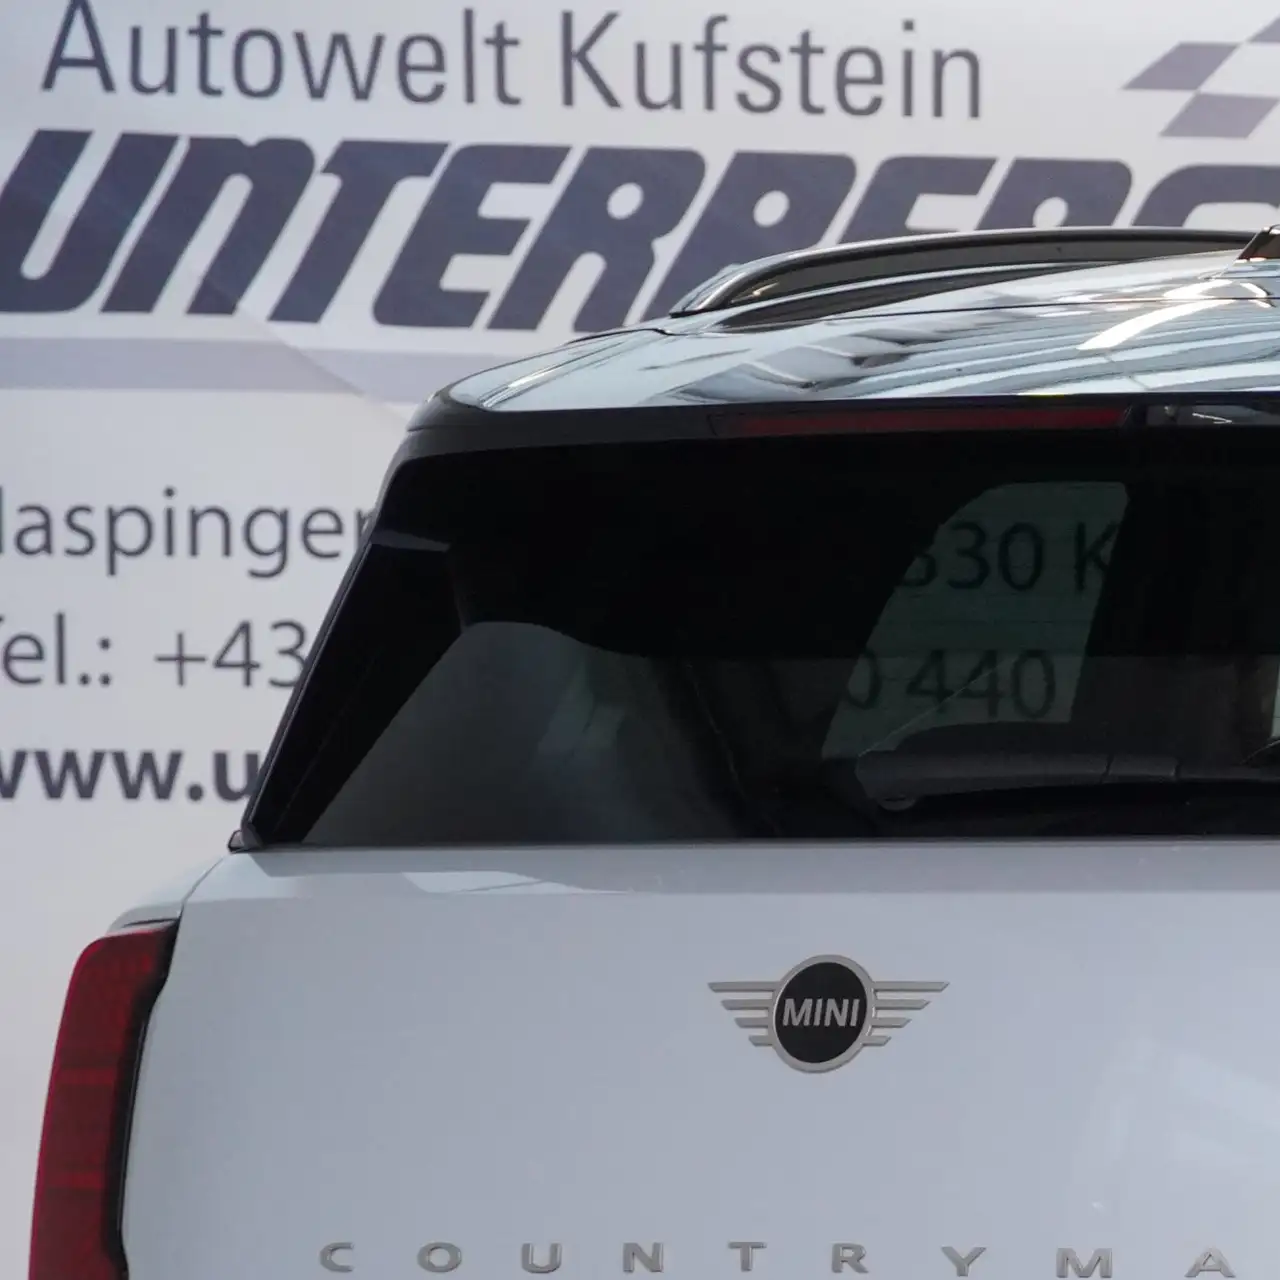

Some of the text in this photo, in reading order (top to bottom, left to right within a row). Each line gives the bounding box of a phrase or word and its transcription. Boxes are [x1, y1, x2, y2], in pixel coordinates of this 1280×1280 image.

[40, 0, 982, 119] Autowelt Kufstein
[782, 997, 861, 1028] MINI
